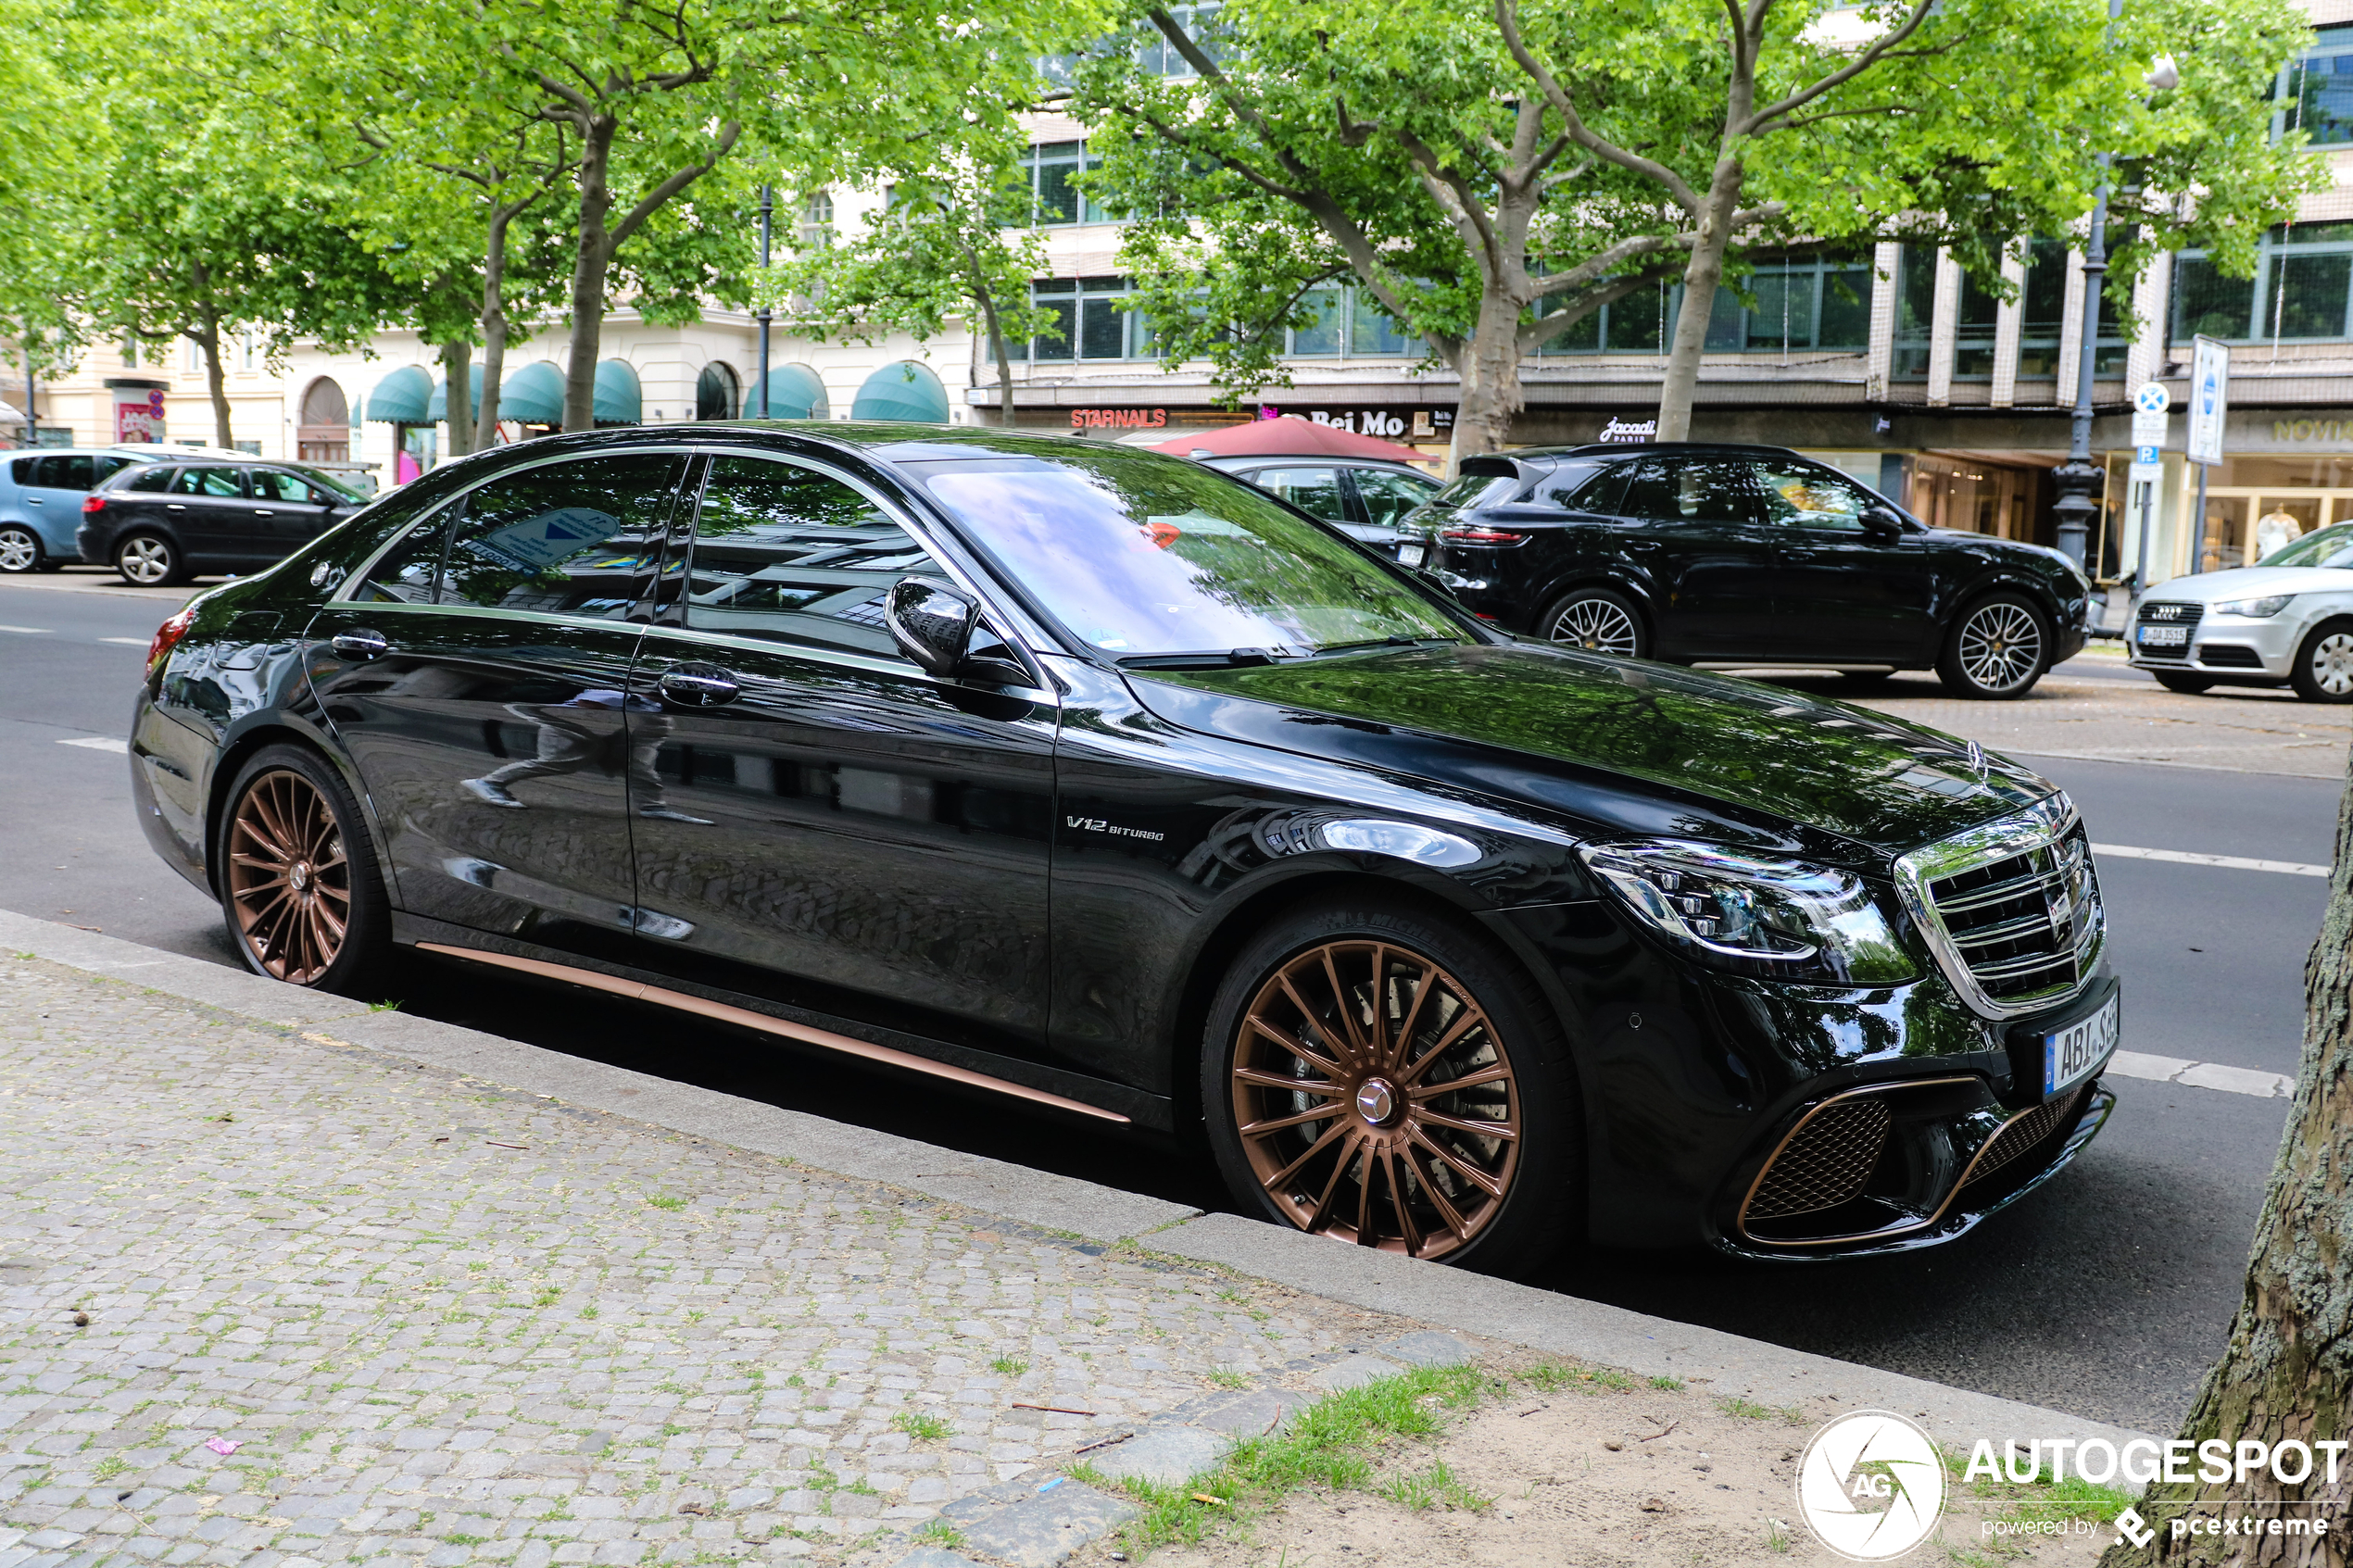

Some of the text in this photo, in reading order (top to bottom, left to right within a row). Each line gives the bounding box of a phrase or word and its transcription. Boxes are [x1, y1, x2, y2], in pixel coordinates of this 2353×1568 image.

[1071, 408, 1166, 427] STARNAILS
[1311, 410, 1404, 436] Bei Mo
[1599, 416, 1656, 443] jacadi
[1614, 435, 1645, 444] PARIS
[1066, 815, 1164, 842] V12 BITURBO
[1369, 912, 1466, 962] MICHELIN
[2060, 1021, 2092, 1081] ABI
[2046, 1072, 2052, 1085] D
